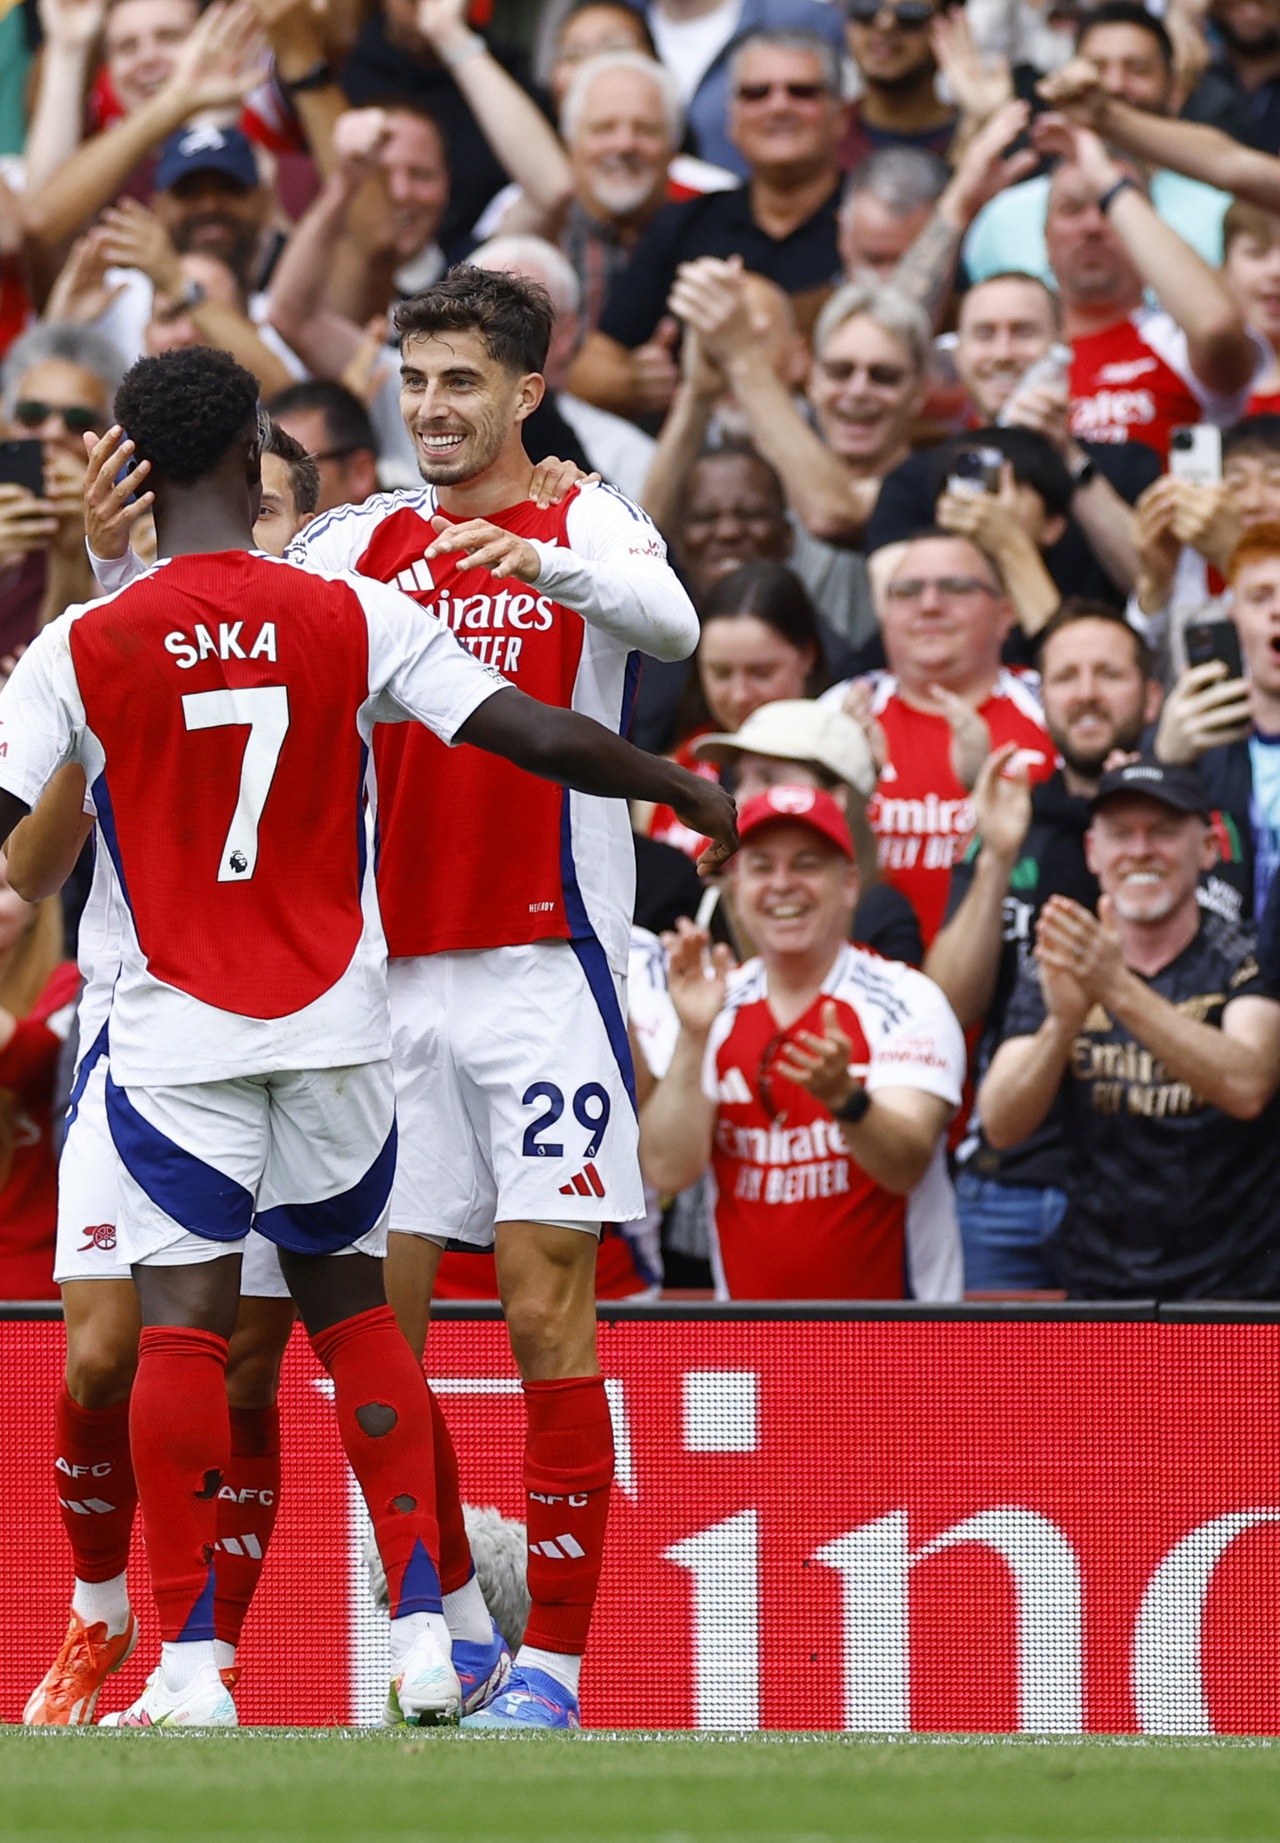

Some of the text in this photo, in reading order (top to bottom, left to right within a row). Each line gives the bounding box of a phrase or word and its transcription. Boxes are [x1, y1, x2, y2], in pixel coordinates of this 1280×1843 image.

[426, 588, 553, 632] irates
[164, 620, 278, 670] SAKA
[458, 635, 523, 672] TTER
[181, 685, 290, 883] 7
[521, 1081, 611, 1158] 29
[716, 1118, 849, 1166] Emirate
[55, 1456, 112, 1478] AFC
[217, 1484, 274, 1506] AFC
